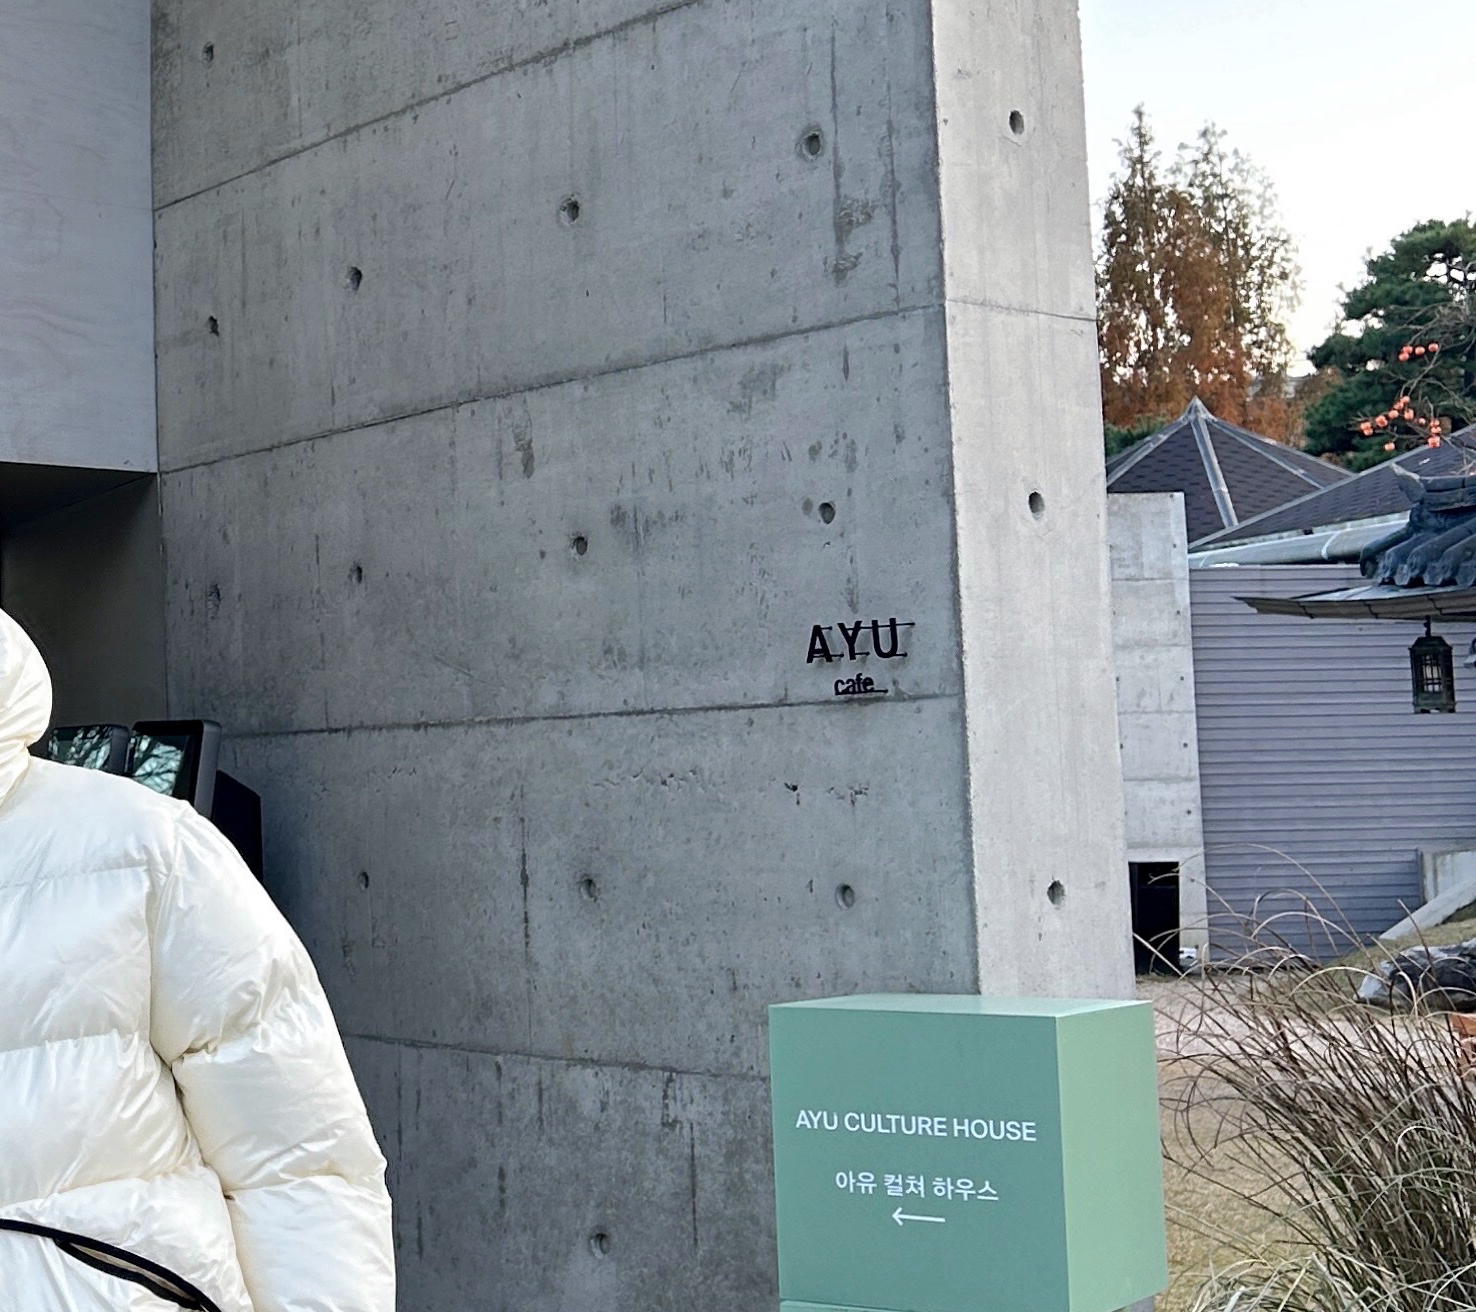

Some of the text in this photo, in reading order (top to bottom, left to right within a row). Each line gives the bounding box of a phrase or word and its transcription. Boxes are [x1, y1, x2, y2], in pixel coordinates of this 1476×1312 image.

[806, 618, 900, 663] AYU
[834, 673, 875, 695] cafe
[795, 1108, 1037, 1142] AYU CULTURE HOUSE
[835, 1171, 1000, 1202] 아유 컬쳐 하우스
